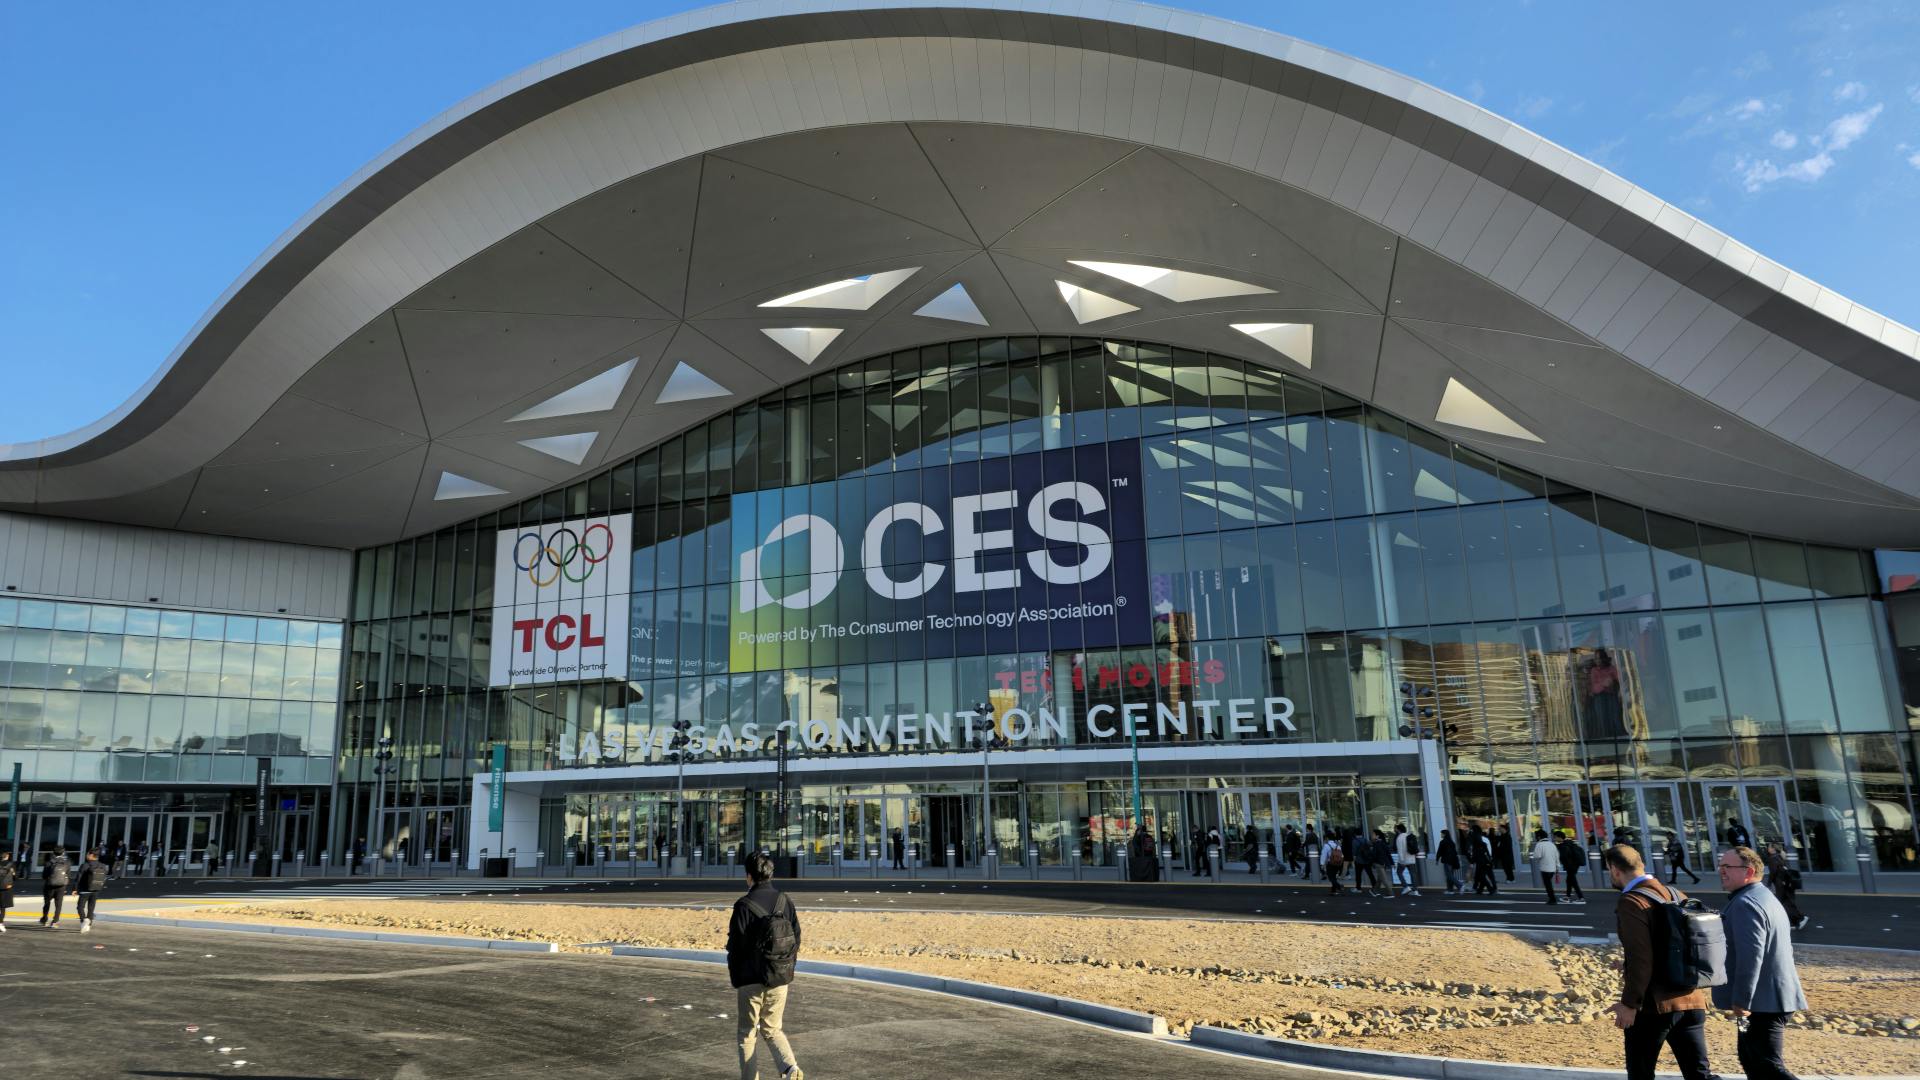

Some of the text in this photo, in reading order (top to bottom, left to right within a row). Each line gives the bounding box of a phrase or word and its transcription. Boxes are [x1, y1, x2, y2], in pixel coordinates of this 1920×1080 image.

[861, 481, 1112, 600] CES
[513, 613, 604, 653] TCL
[738, 627, 797, 645] Powered
[800, 627, 817, 642] by
[819, 624, 846, 638] The
[849, 619, 924, 636] Consumer
[926, 611, 1015, 630] Technology
[508, 663, 608, 677] Worldwide Olympic Partner
[631, 654, 645, 663] The
[1098, 659, 1226, 689] MOVES
[560, 730, 624, 760] LAS
[635, 722, 760, 757] VEGAS
[1087, 696, 1297, 738] CENTER
